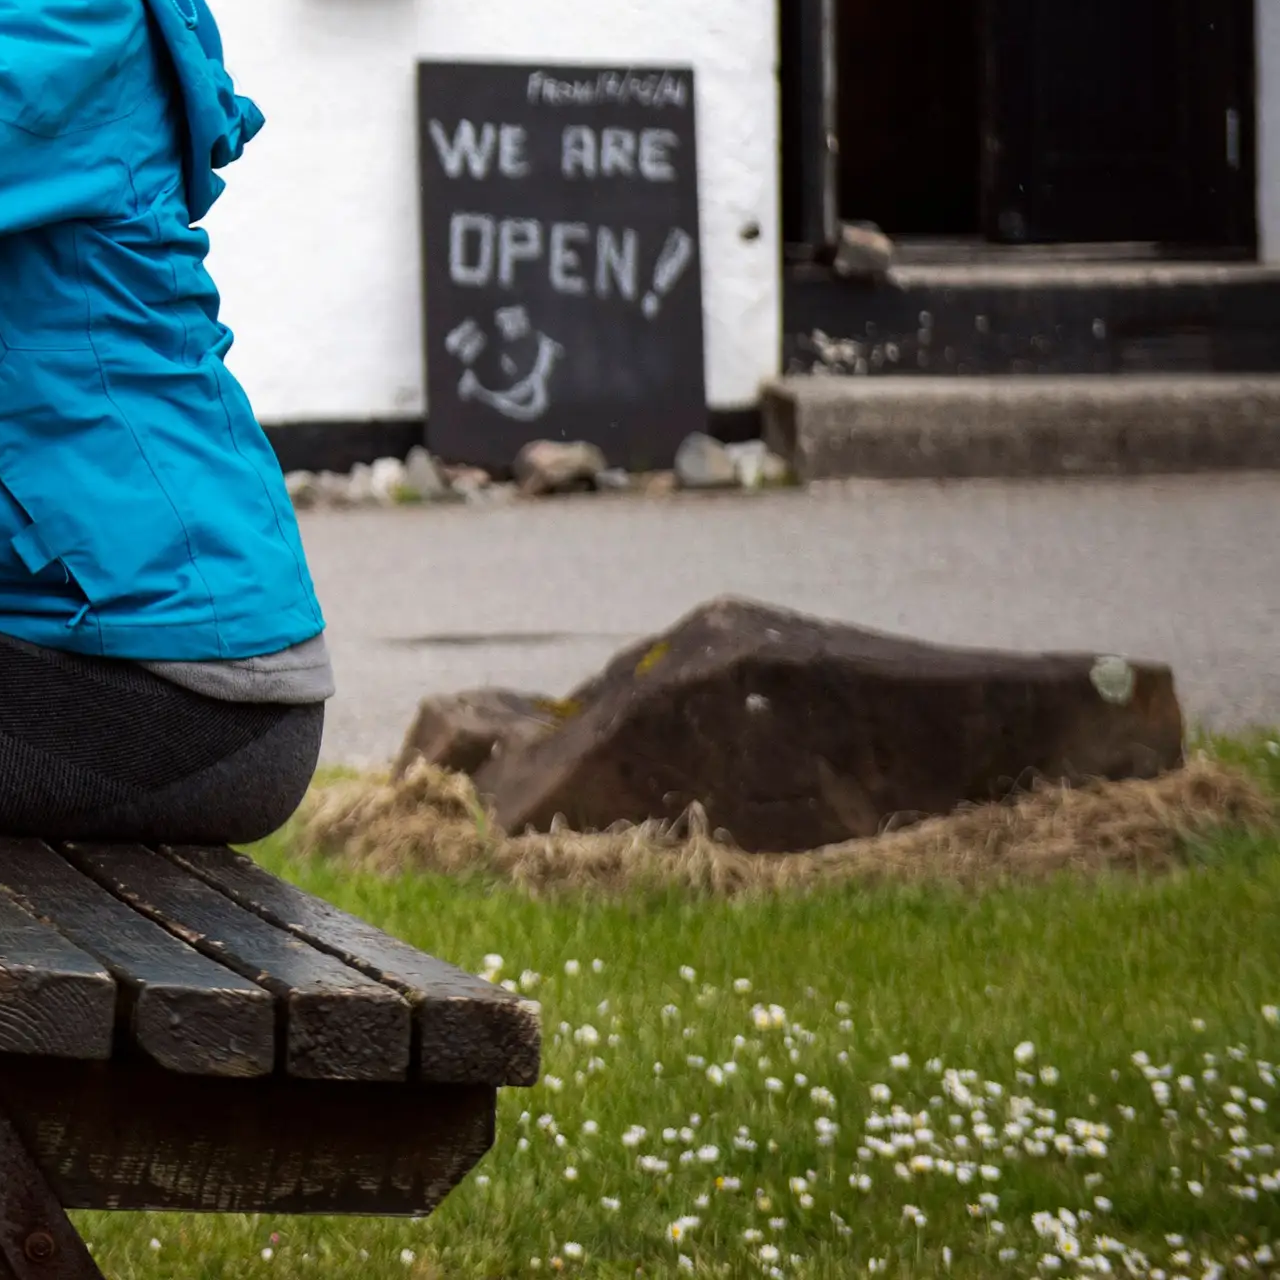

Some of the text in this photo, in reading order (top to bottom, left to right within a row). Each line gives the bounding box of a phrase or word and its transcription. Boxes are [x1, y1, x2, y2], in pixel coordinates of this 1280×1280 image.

[428, 118, 680, 182] WE ARE
[448, 210, 694, 318] OPEN!
